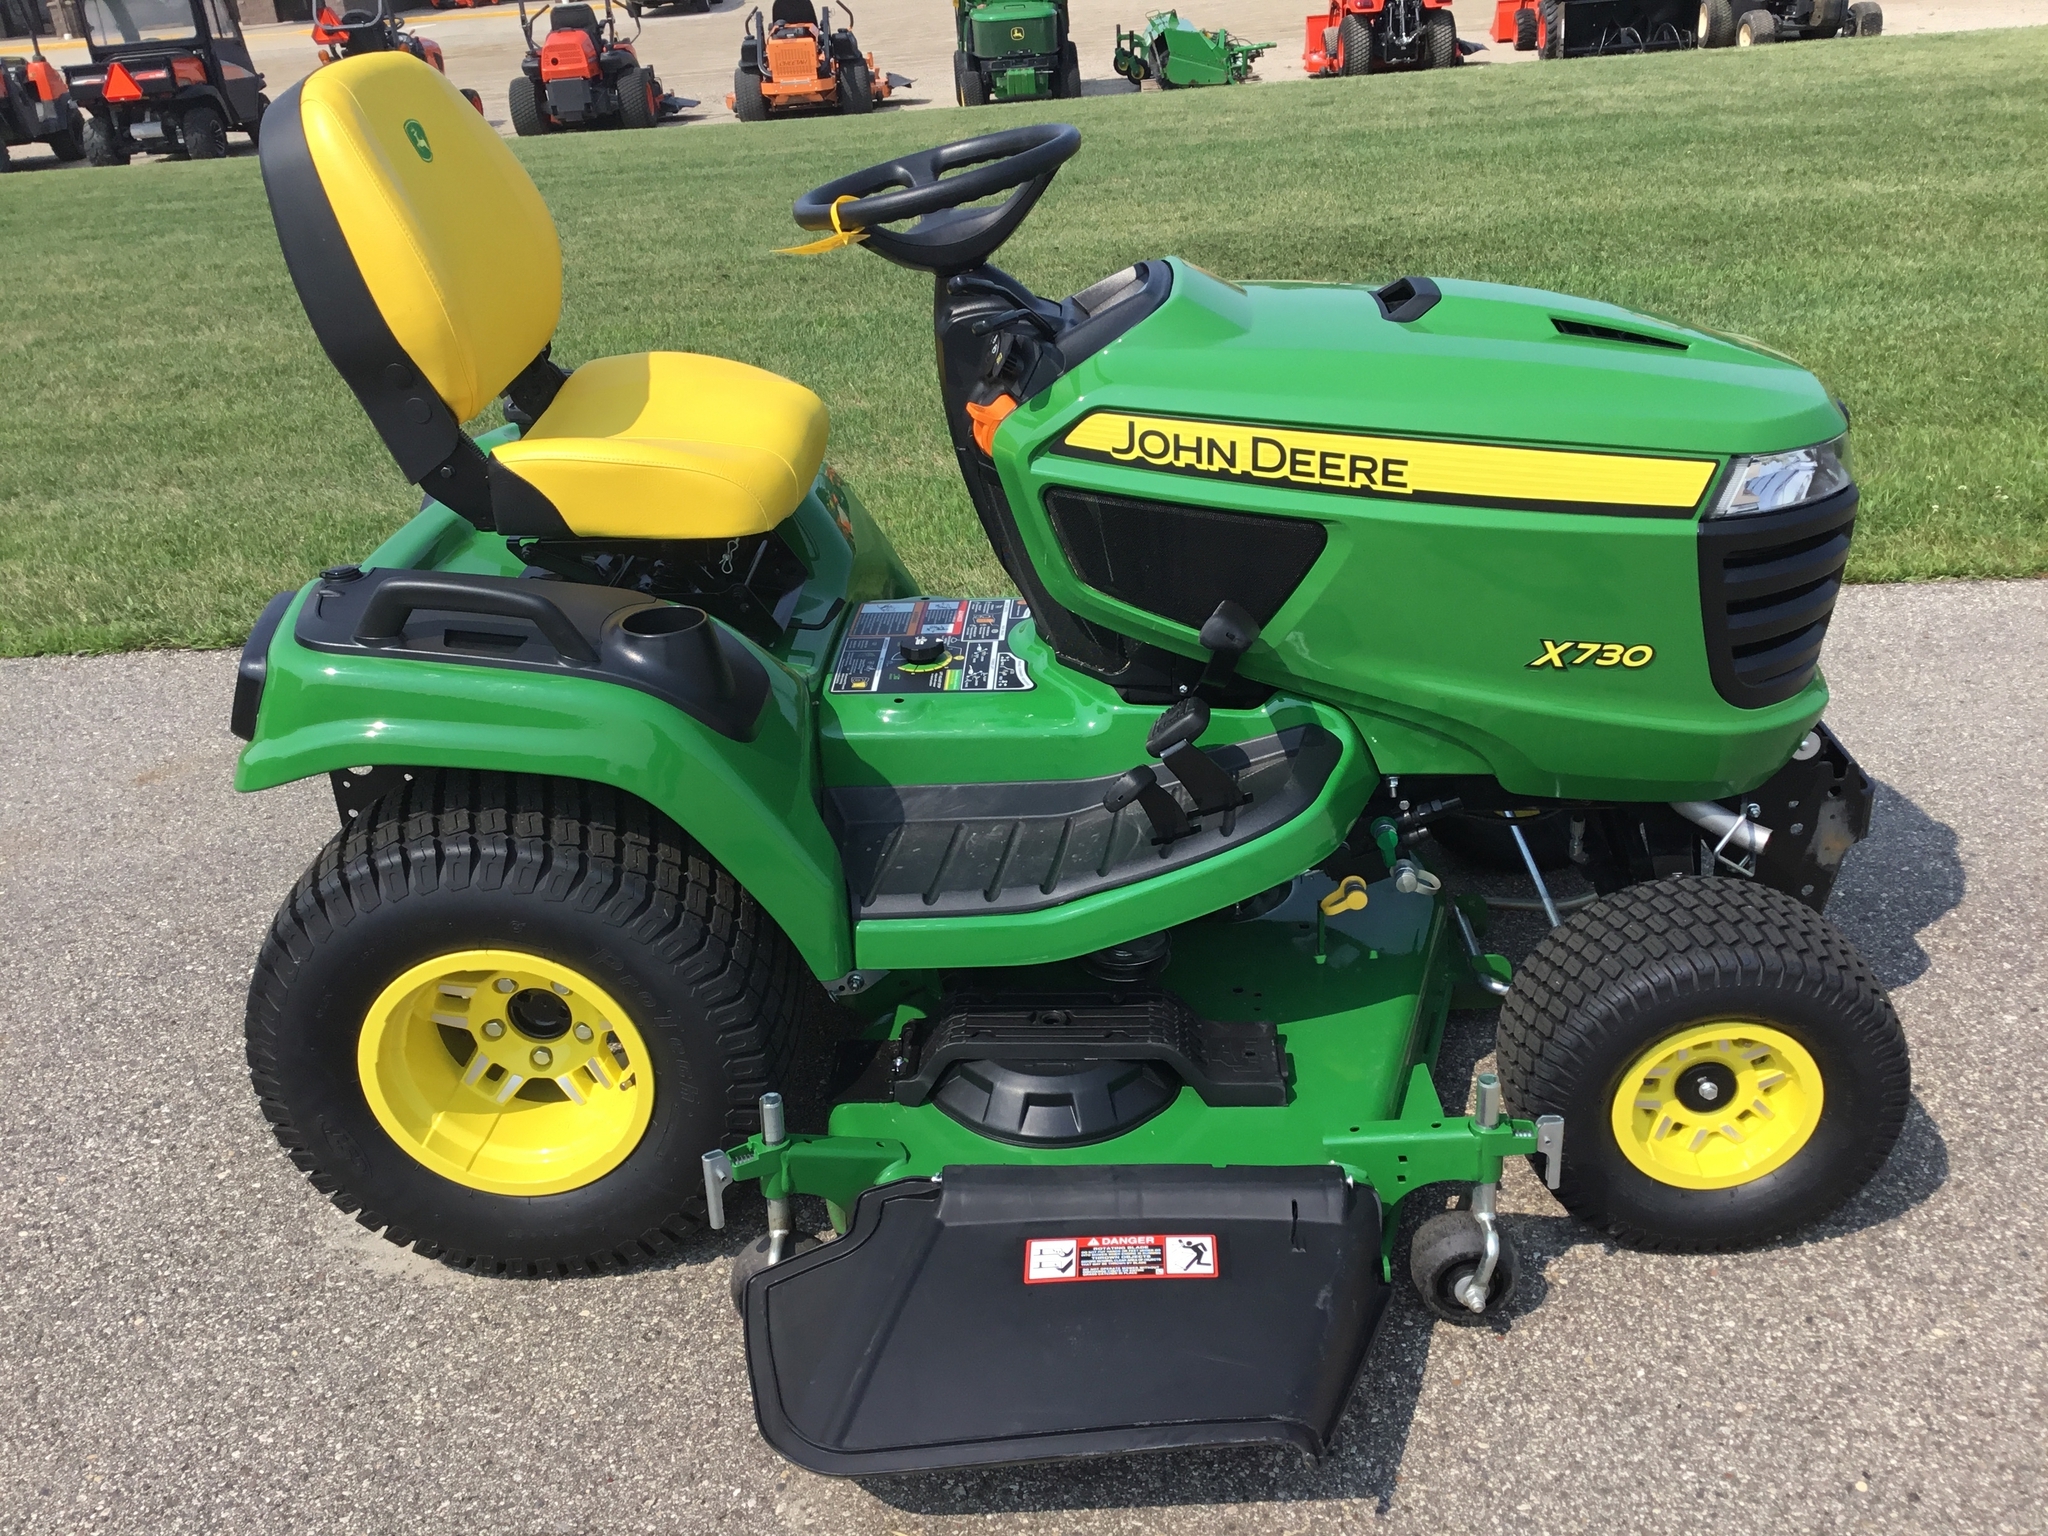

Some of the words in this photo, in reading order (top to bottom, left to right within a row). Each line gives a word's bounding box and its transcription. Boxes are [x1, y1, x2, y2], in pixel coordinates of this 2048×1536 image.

[1111, 420, 1237, 470] JOHN
[1251, 436, 1410, 489] DEERE
[1525, 639, 1655, 669] X730
[1102, 1237, 1155, 1245] DANGER
